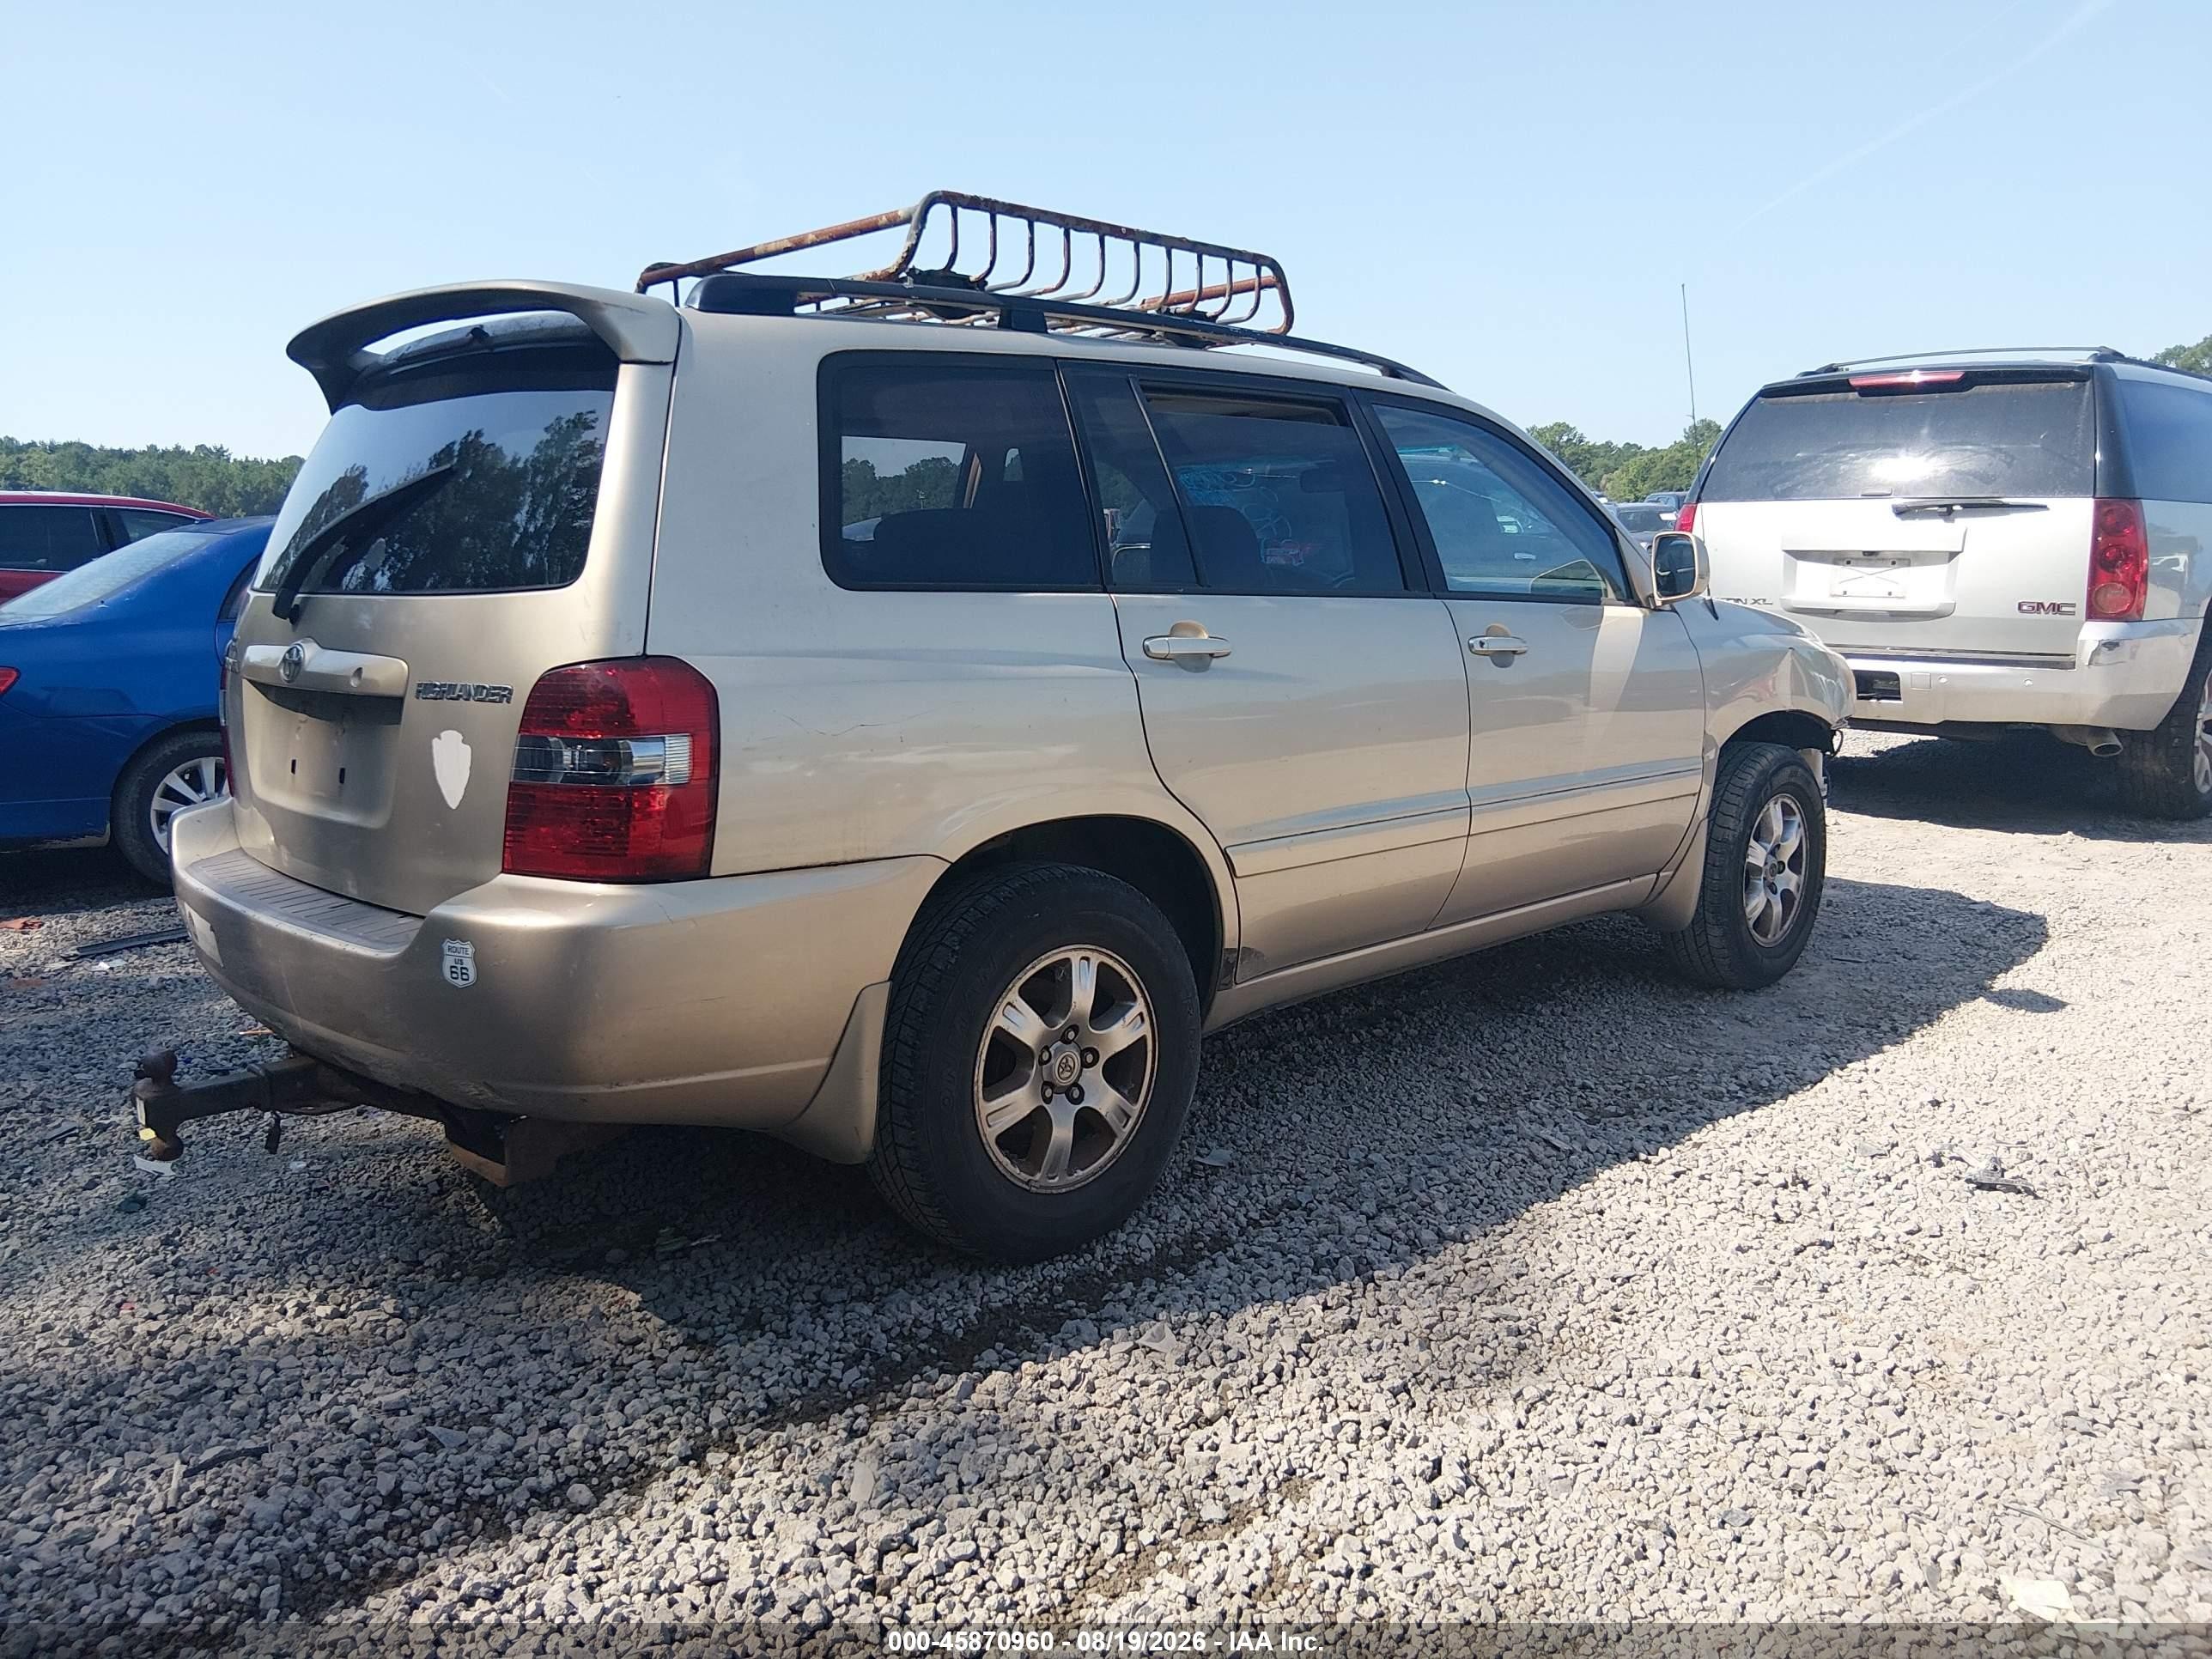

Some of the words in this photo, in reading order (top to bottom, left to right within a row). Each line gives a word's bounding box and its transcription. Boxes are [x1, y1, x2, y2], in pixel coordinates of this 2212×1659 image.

[2018, 601, 2076, 616] GMC
[416, 682, 514, 703] HIGHLANDER
[447, 945, 470, 955] ROUTE
[450, 965, 470, 981] 66
